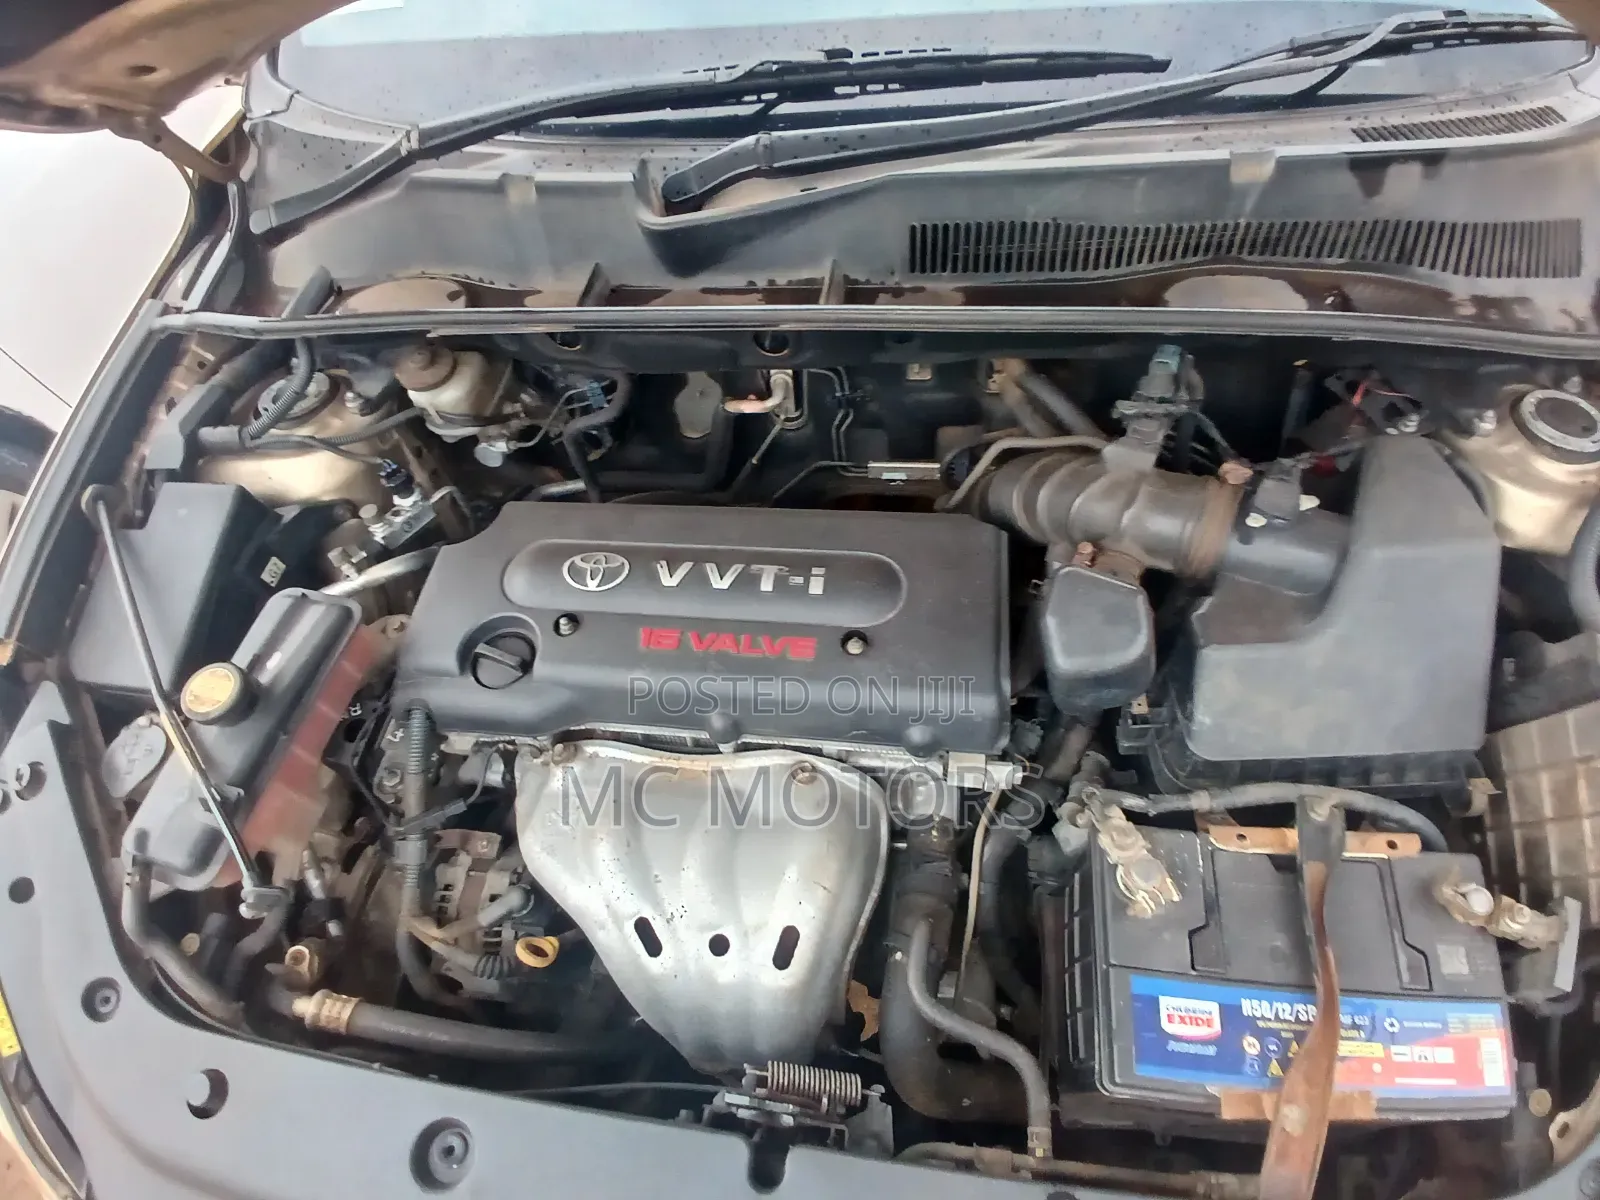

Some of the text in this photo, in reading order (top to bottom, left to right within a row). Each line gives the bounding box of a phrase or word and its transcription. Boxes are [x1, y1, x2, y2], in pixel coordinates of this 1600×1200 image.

[656, 560, 826, 595] VVT-i
[640, 627, 817, 661] 16 VALVE
[1166, 1013, 1215, 1029] EXIDE
